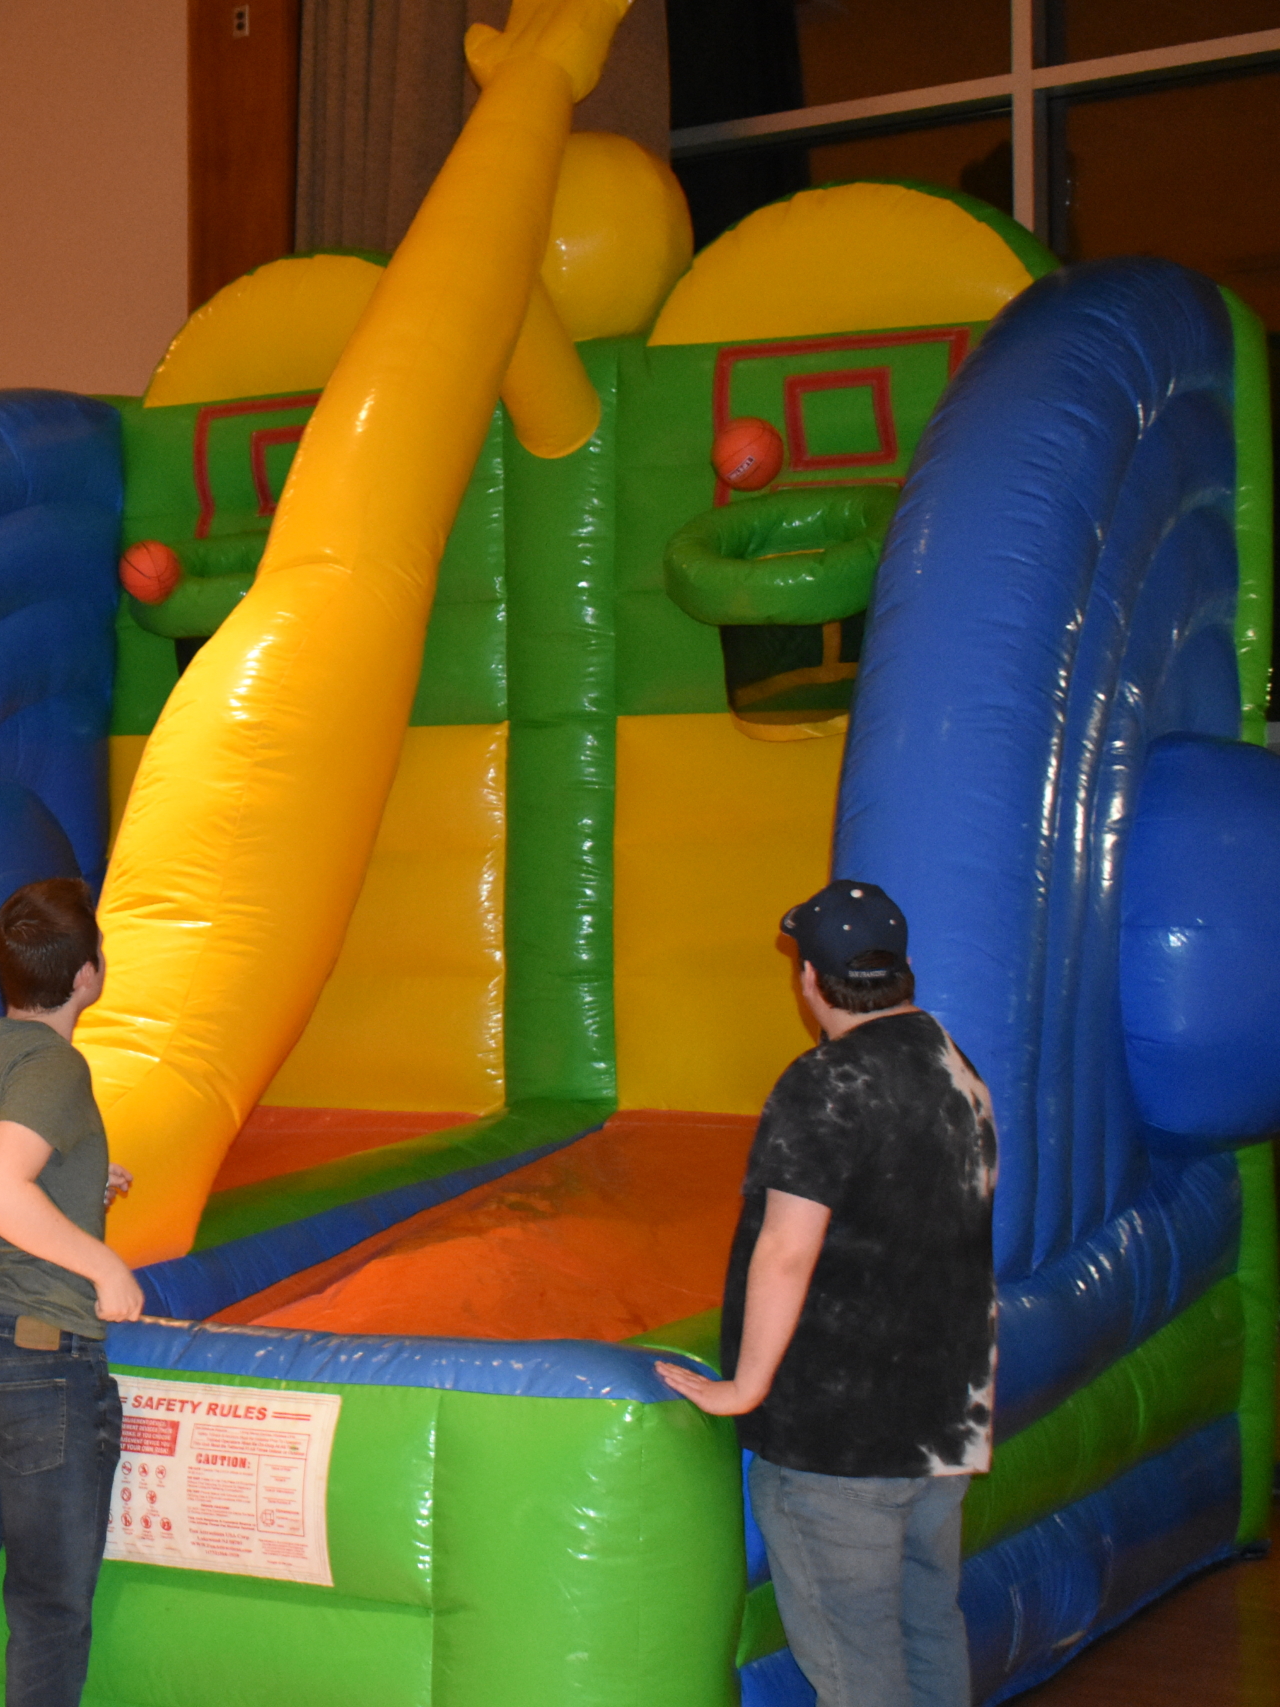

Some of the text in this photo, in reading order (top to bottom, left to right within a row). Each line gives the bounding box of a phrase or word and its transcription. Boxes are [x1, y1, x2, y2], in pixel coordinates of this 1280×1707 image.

[131, 1394, 268, 1421] SAFETY RULES
[127, 1443, 141, 1452] YOUR
[195, 1453, 251, 1469] CAUTION:
